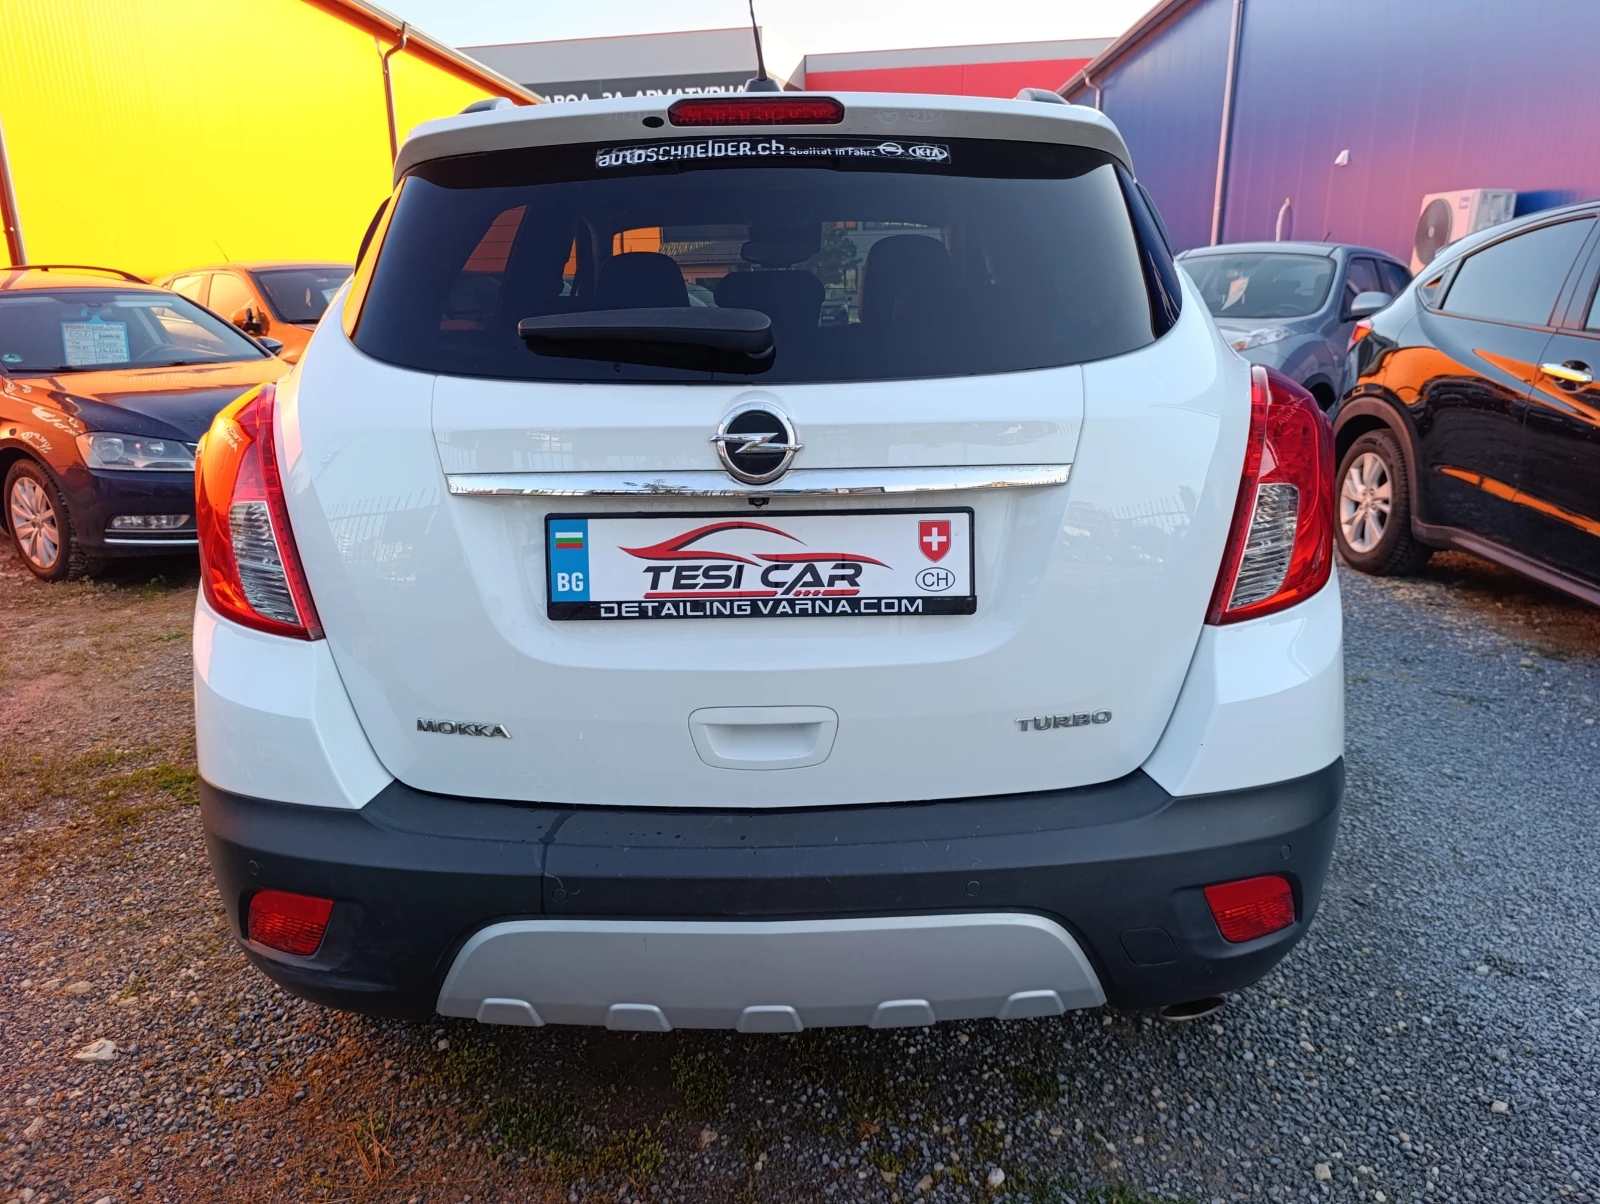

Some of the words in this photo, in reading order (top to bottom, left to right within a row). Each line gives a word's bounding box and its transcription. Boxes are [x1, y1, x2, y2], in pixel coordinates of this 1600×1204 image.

[915, 147, 942, 157] KIA
[557, 572, 584, 592] BG
[643, 564, 746, 590] TESI
[760, 562, 863, 596] CAR
[921, 572, 949, 587] CH
[416, 718, 512, 740] MOKKA
[1014, 708, 1113, 732] TURBO
